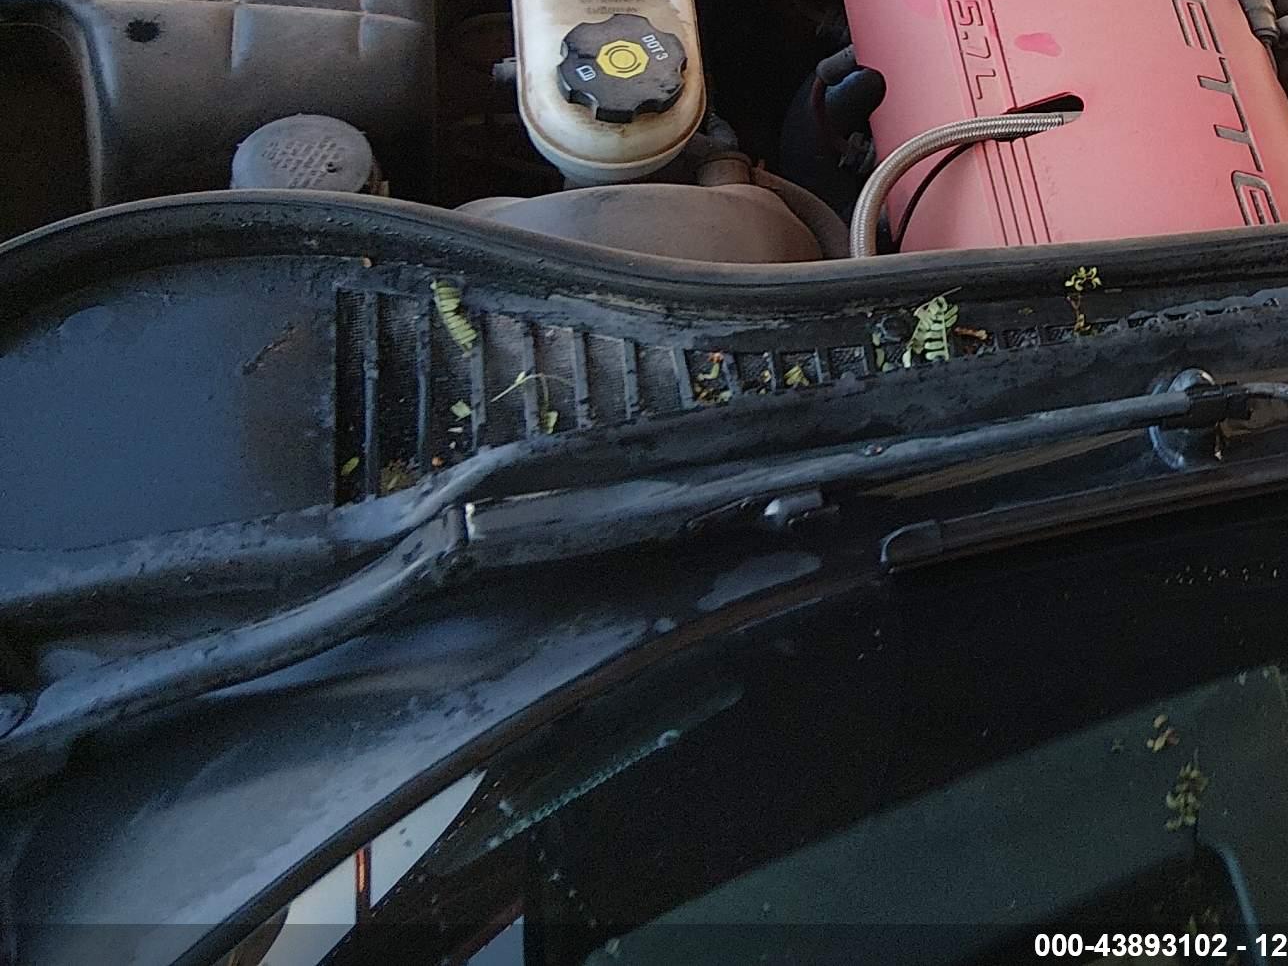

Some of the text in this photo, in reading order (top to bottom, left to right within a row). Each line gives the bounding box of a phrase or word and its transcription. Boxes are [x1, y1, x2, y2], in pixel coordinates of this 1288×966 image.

[641, 34, 669, 61] DOT 3
[956, 0, 997, 100] 5.7L
